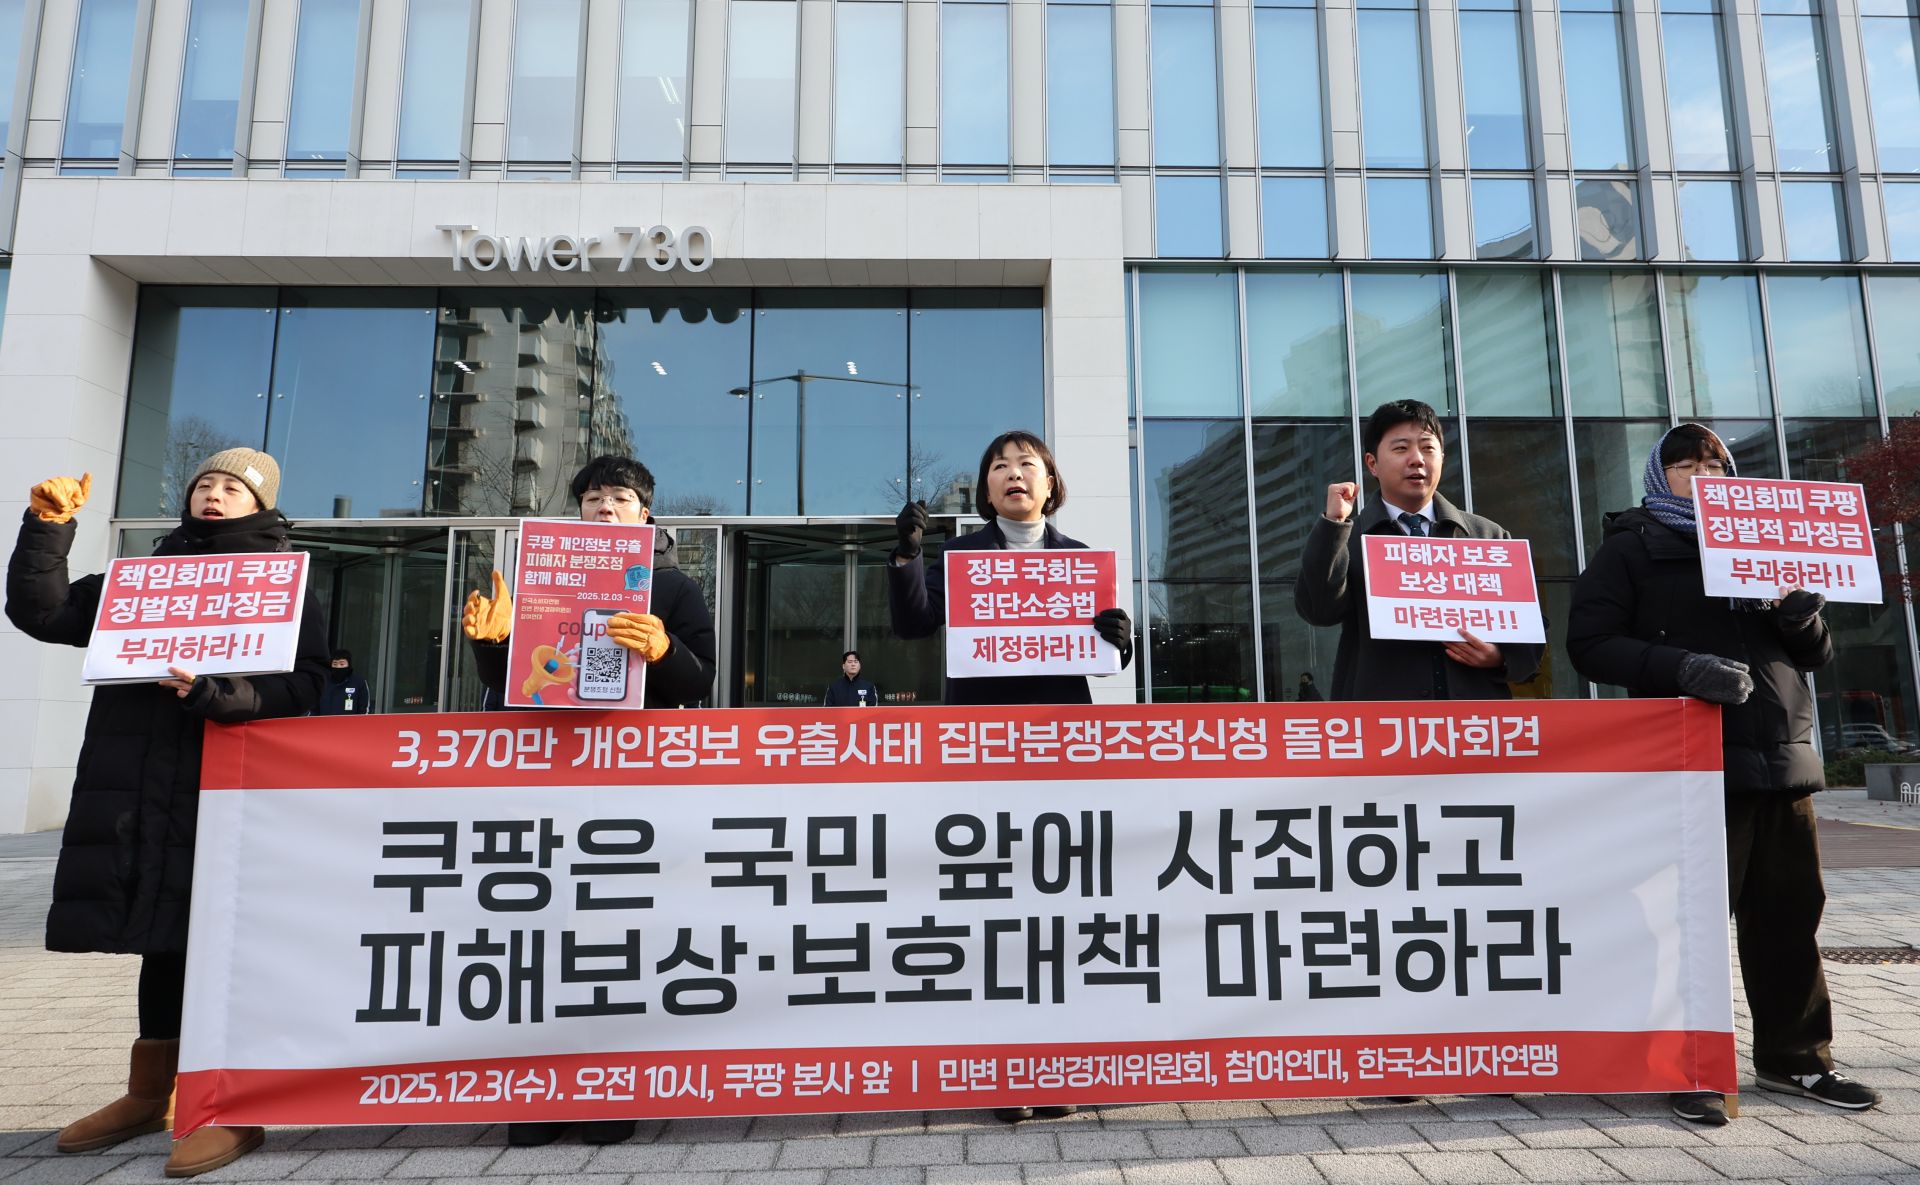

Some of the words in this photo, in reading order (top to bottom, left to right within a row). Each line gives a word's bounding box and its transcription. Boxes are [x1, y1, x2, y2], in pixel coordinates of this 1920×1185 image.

[435, 224, 600, 272] Tower
[614, 225, 713, 272] 730
[1703, 484, 1805, 514] 책임회피
[1808, 489, 1858, 516] 쿠팡
[527, 535, 555, 550] 쿠팡
[559, 536, 611, 552] 개인정보
[615, 539, 641, 554] 유출
[1708, 516, 1785, 545] 징벌적
[1788, 520, 1864, 549] 과징금
[526, 553, 566, 567] 피해자
[570, 554, 623, 570] 분쟁조정
[1384, 542, 1457, 567] 피해자
[1461, 545, 1512, 567] 보호
[116, 560, 234, 590] 책임회피
[237, 559, 297, 585] 쿠팡
[524, 571, 551, 585] 함께
[555, 572, 586, 587] 해요!
[967, 558, 1018, 585] 정부
[1021, 558, 1098, 585] 국회는
[1399, 571, 1448, 594] 보상
[1453, 572, 1503, 596] 대책
[109, 593, 199, 624] 징벌적
[201, 590, 291, 619] 과징금
[577, 592, 622, 601] 2025.12.03
[970, 591, 1095, 620] 집단소송법
[558, 621, 607, 641] coup
[392, 726, 558, 775] 3,370만
[571, 725, 741, 769] 개인정보
[755, 721, 922, 767] 유출사태
[938, 716, 1268, 764] 집단분쟁조정신청
[1282, 716, 1364, 760] 돌입
[1379, 714, 1540, 759] 기자회견
[373, 817, 660, 913] 쿠팡은
[704, 813, 888, 907] 국민
[934, 810, 1113, 901] 앞에
[1157, 802, 1523, 894] 사죄하고
[1204, 906, 1572, 1001] 마련하라
[359, 1069, 564, 1105] 2025.12.3(수).
[572, 1066, 636, 1101] 오전
[644, 1064, 714, 1103] 10시,
[723, 1061, 785, 1098] 쿠팡
[792, 1061, 854, 1097] 본사
[861, 1060, 893, 1095] 앞
[939, 1058, 997, 1092] 민변
[1006, 1049, 1218, 1089] 민생경제위원회,
[1225, 1048, 1348, 1084] 참여연대,
[1357, 1044, 1558, 1080] 한국소비자연맹
